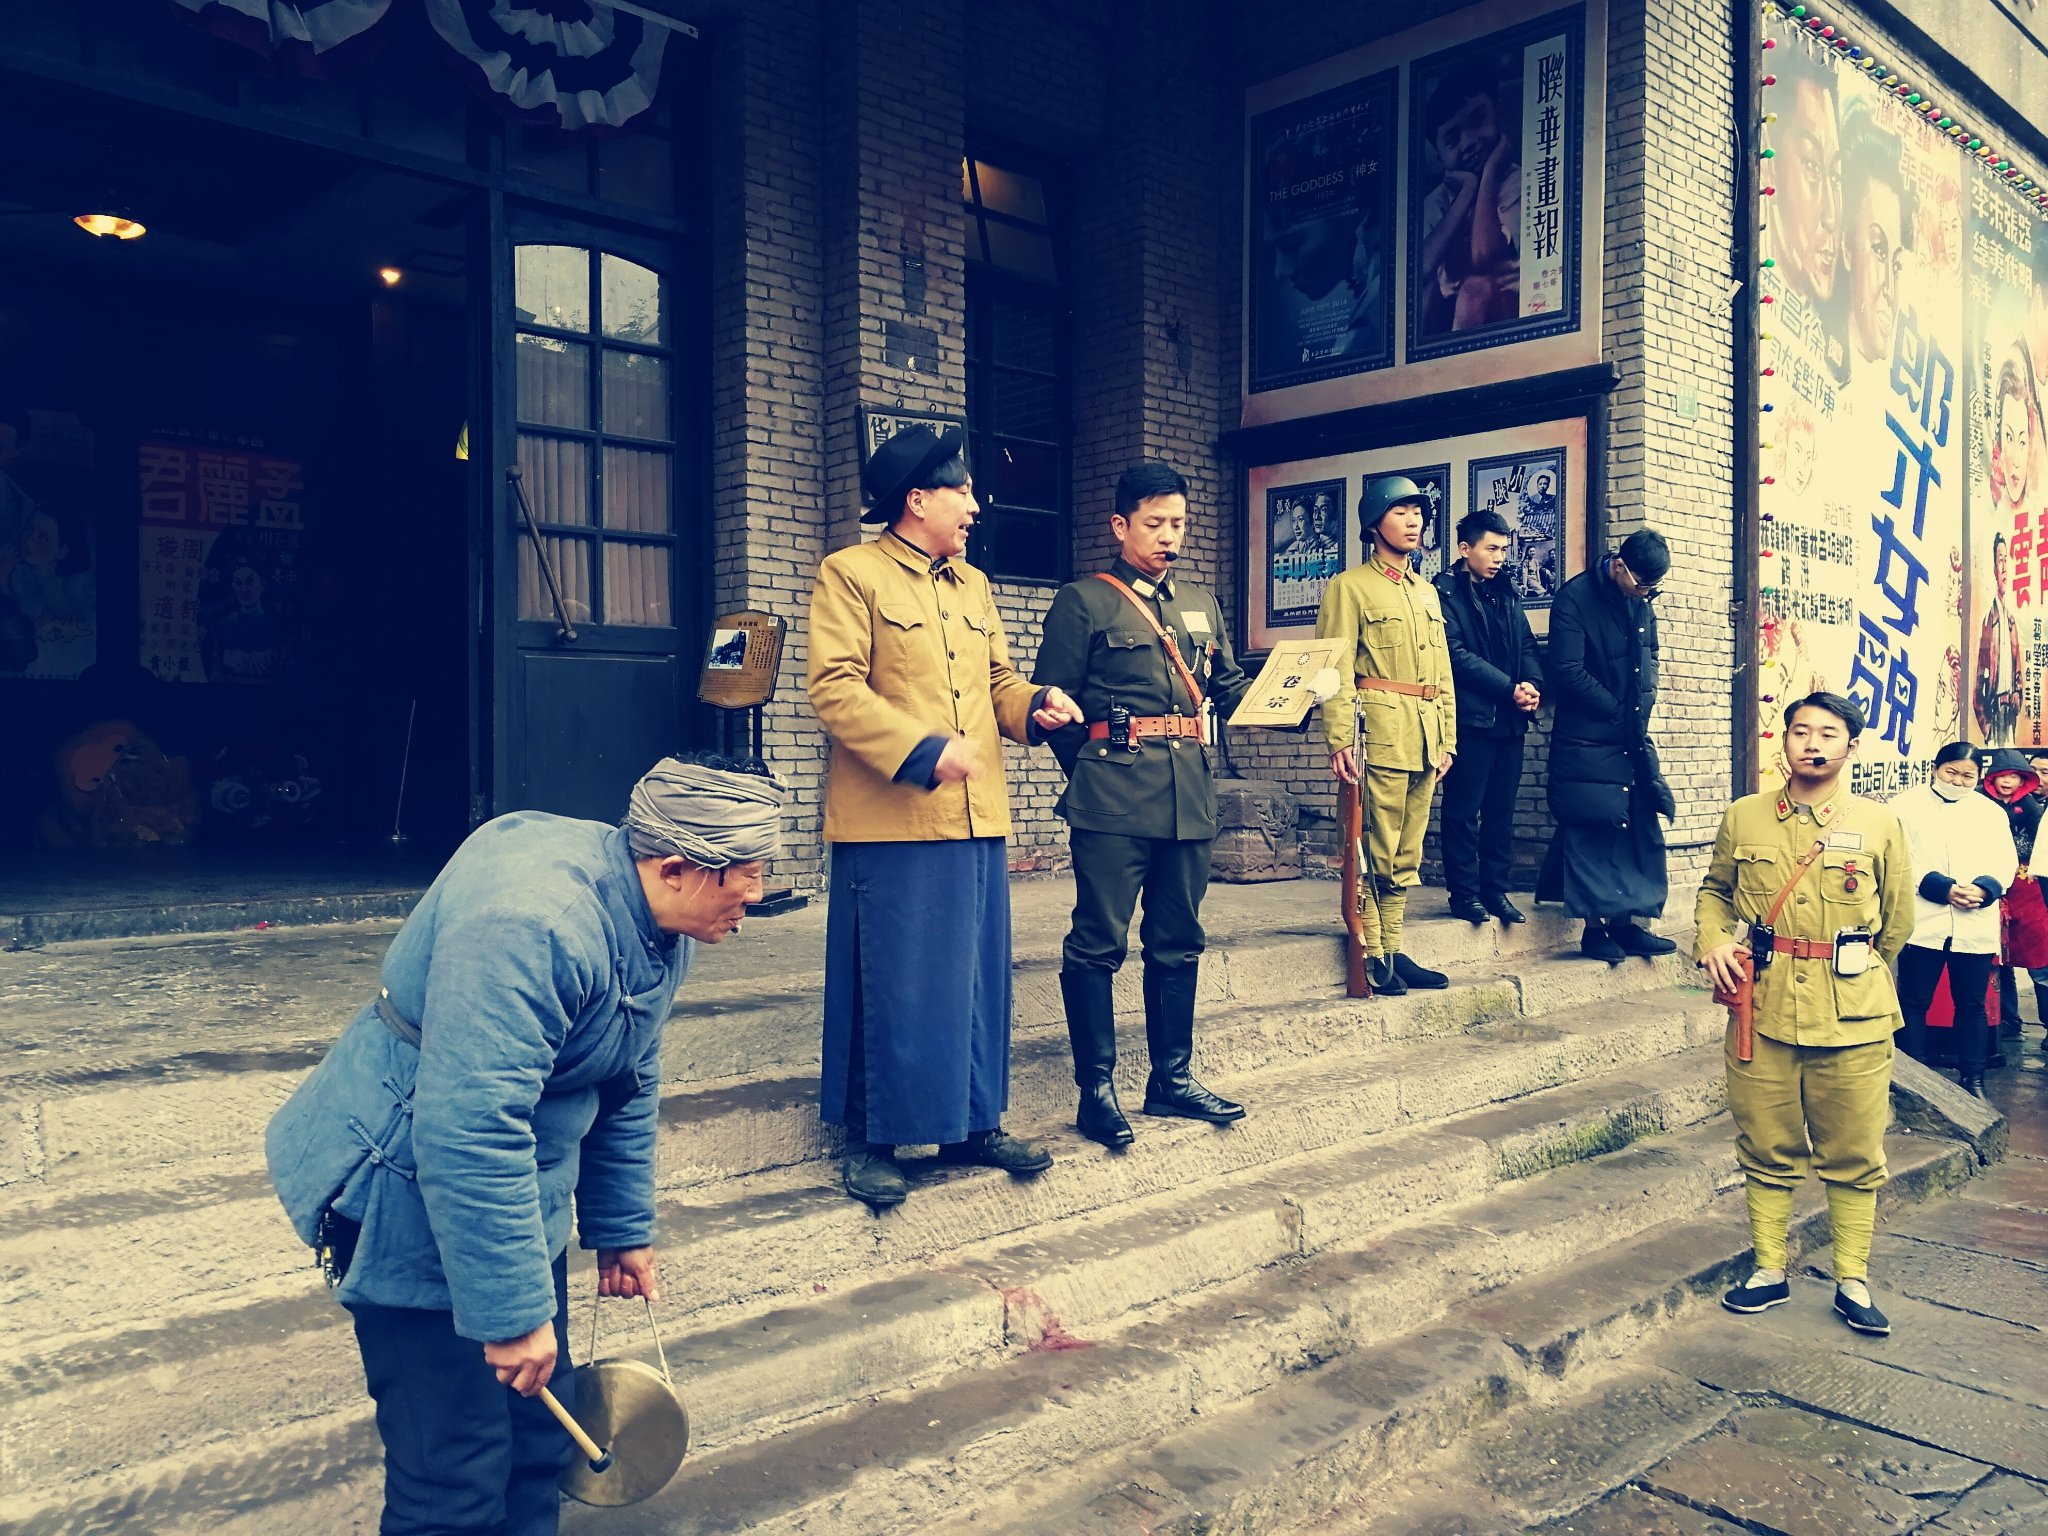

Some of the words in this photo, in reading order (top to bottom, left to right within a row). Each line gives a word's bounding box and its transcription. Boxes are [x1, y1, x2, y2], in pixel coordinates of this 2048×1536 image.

[1268, 187, 1288, 203] THE
[1290, 170, 1344, 197] GODDESS
[140, 445, 305, 530] 孟麗君
[1848, 301, 1955, 757] 郎才女貌
[1265, 675, 1302, 709] 卷宗
